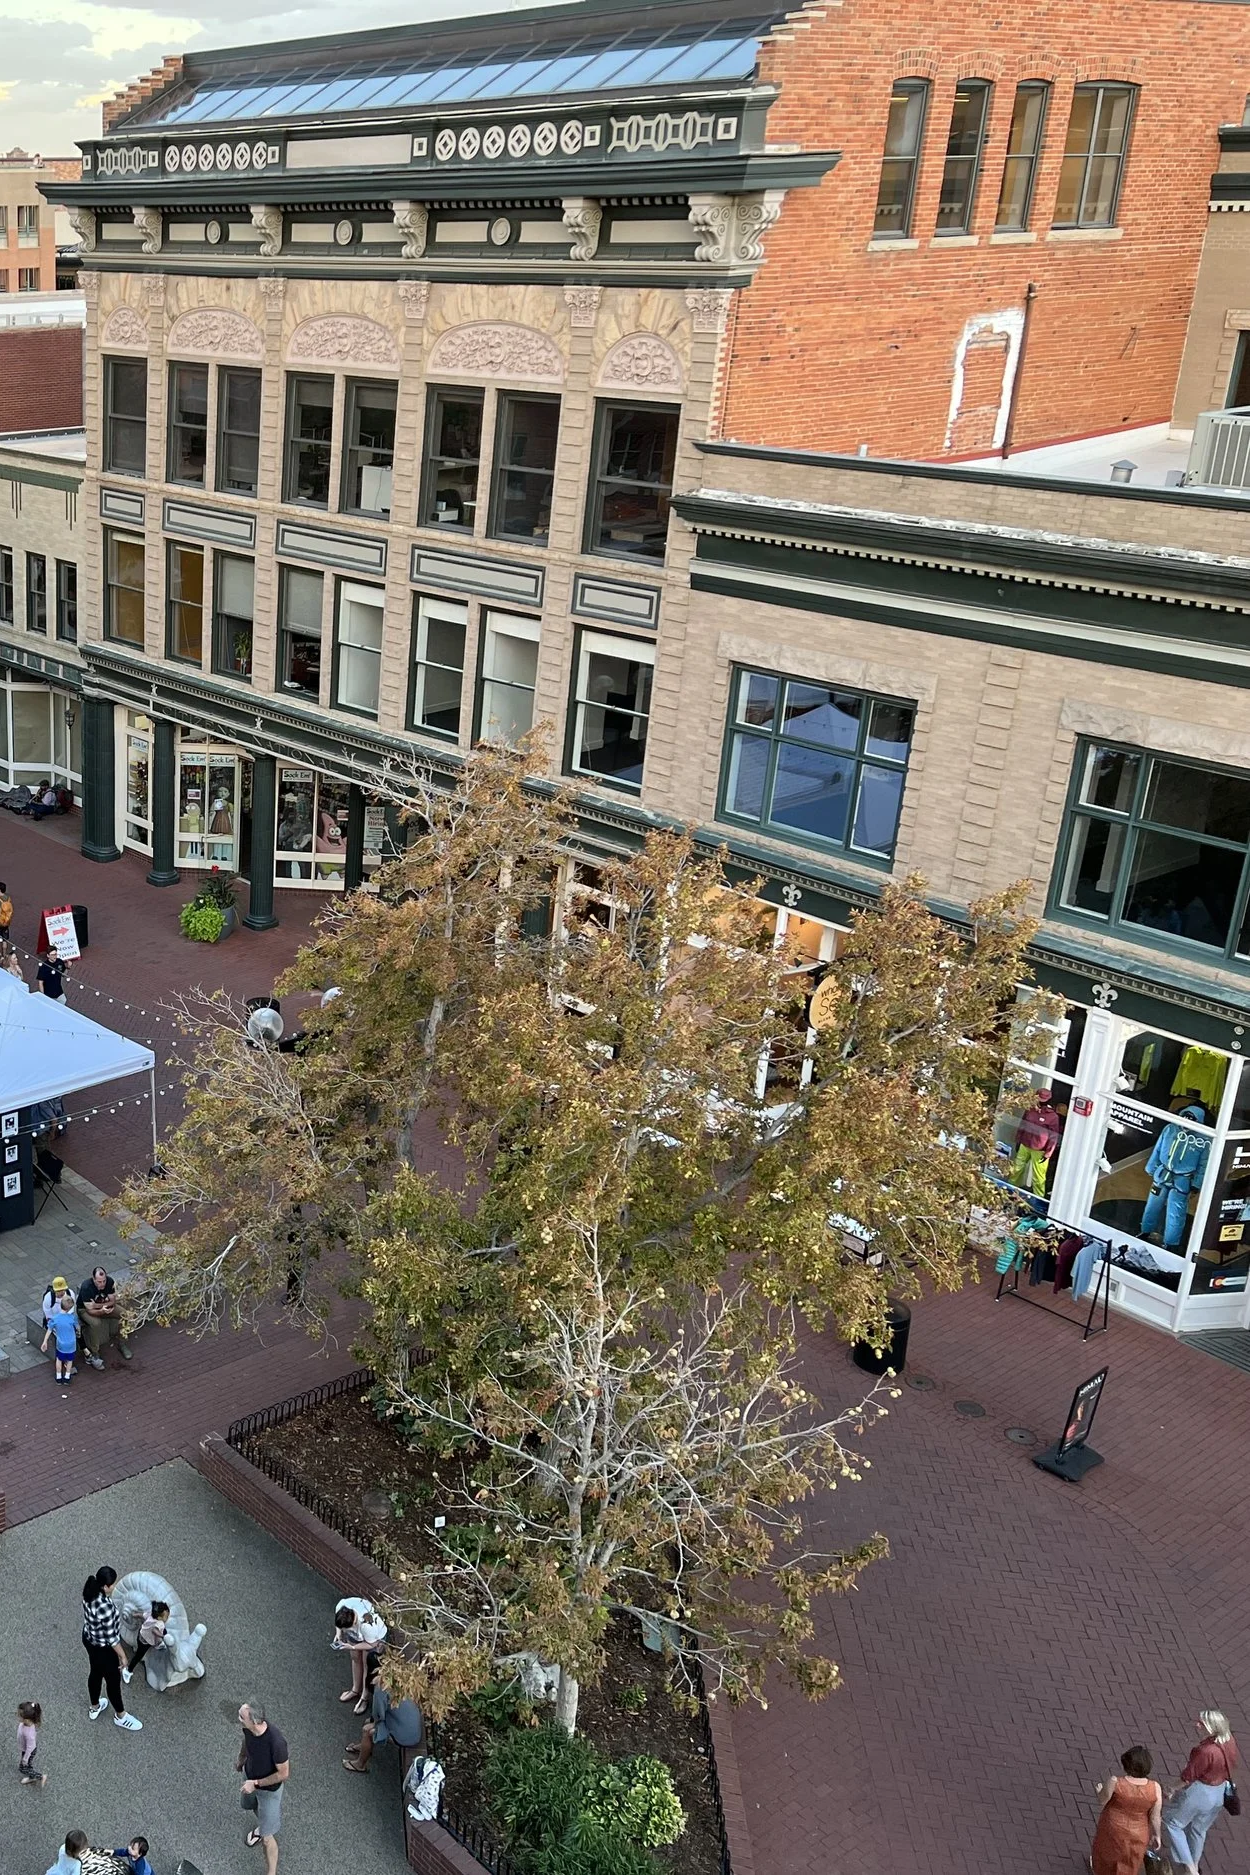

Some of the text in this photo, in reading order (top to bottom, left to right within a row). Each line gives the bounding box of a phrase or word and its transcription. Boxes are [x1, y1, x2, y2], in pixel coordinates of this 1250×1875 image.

[162, 706, 339, 774] CITIZENS NATIONAL
[181, 754, 195, 763] Sock
[209, 755, 224, 764] Sock
[283, 770, 299, 779] Sock
[51, 937, 76, 947] We're
[1108, 1108, 1144, 1127] APPAREL
[1109, 1102, 1154, 1123] MOUNTAIN
